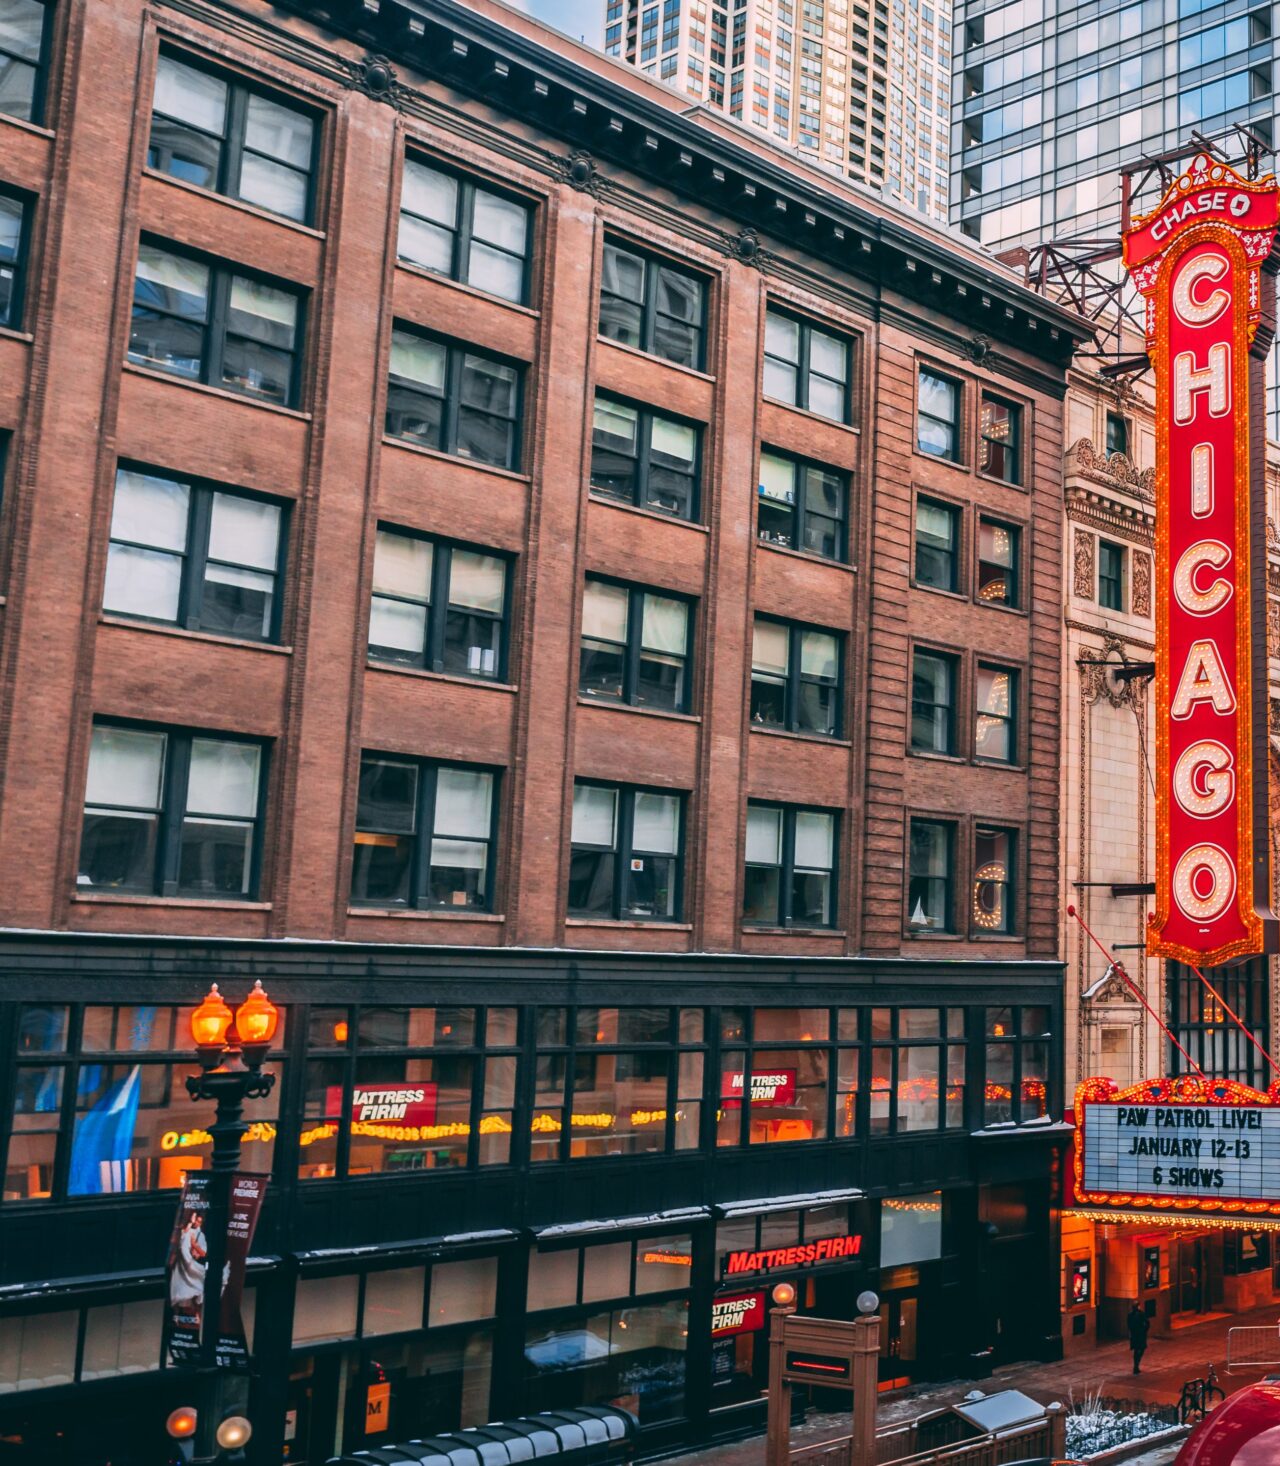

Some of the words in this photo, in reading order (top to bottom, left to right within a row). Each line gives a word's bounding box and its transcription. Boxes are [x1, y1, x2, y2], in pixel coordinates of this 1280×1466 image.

[1150, 191, 1228, 241] CHASE
[1170, 252, 1237, 923] CHICAGO
[359, 1103, 408, 1121] FIRM
[1117, 1107, 1150, 1127] PAW
[1155, 1108, 1215, 1129] PATROL
[1222, 1109, 1263, 1130] LIVE!
[1128, 1136, 1202, 1158] JANUARY
[1211, 1139, 1251, 1160] 12-13
[1152, 1166, 1163, 1186] 6
[1168, 1168, 1225, 1189] SHOWS
[711, 1311, 745, 1330] FIRM
[368, 1401, 382, 1416] M
